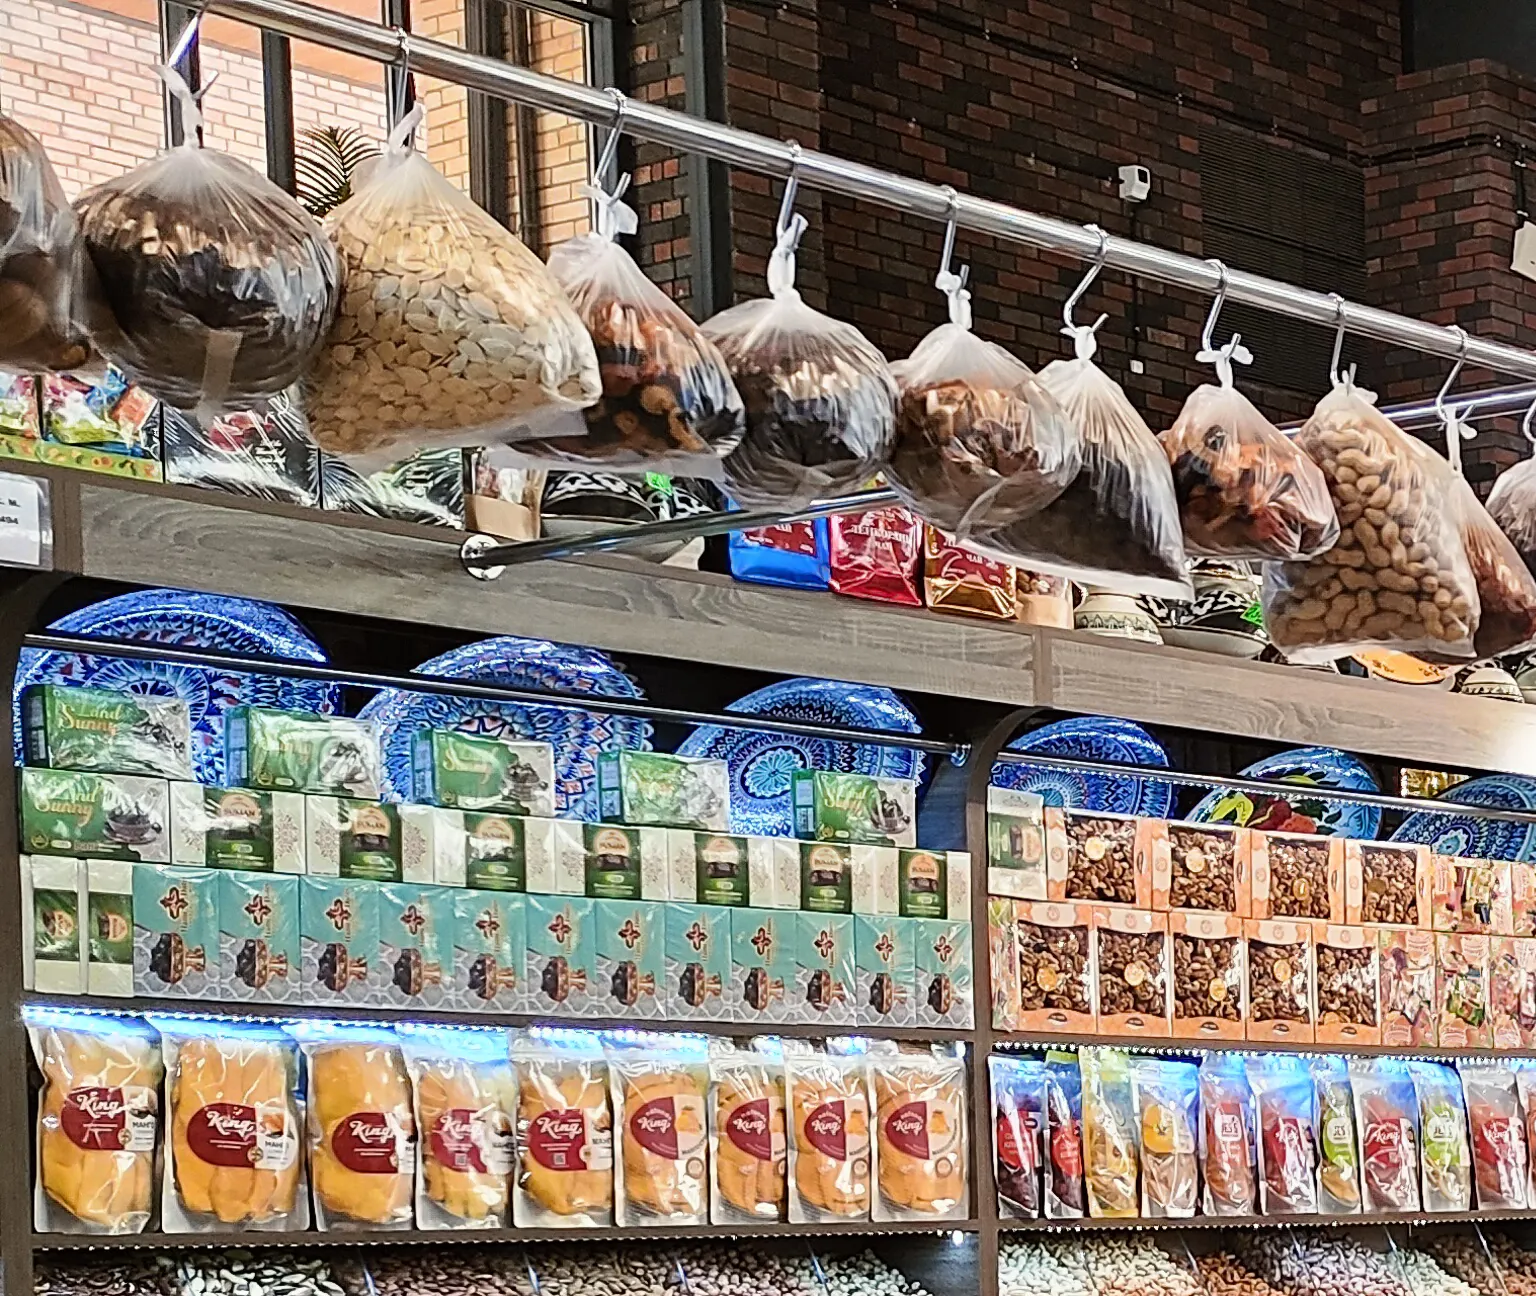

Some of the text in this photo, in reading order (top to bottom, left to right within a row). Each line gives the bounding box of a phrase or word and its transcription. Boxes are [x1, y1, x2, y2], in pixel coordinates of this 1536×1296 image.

[78, 1093, 129, 1120] King
[205, 1110, 257, 1142] King
[536, 1116, 583, 1141] King
[637, 1116, 671, 1134] King
[734, 1117, 767, 1136] King
[811, 1119, 841, 1136] King
[892, 1119, 925, 1136] King
